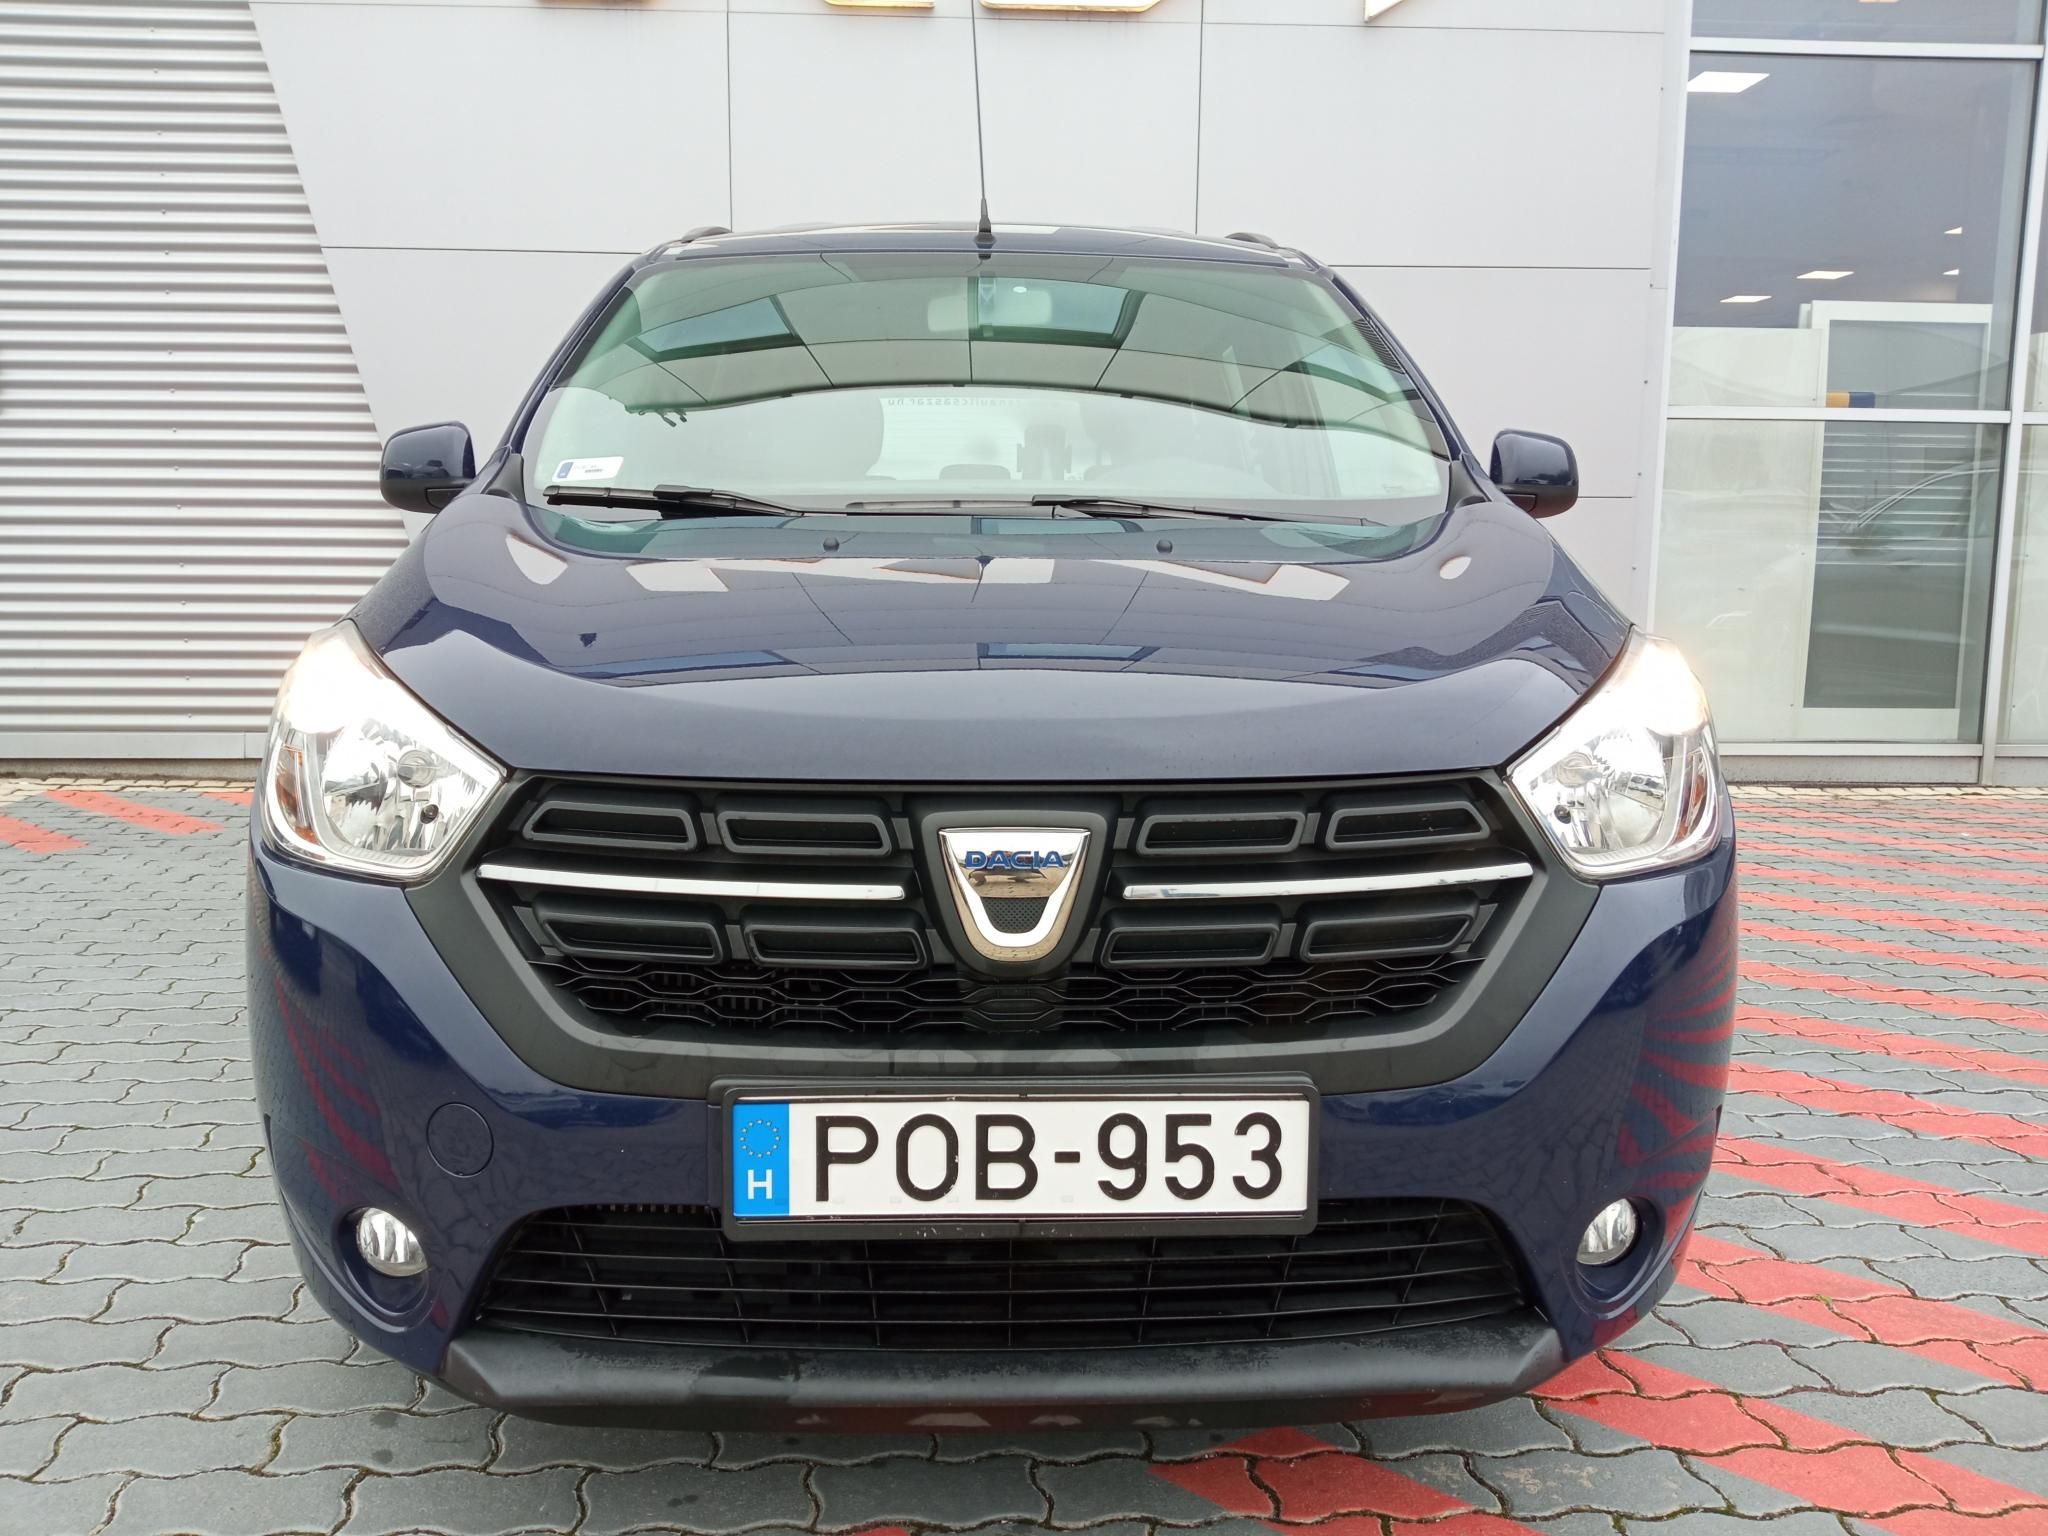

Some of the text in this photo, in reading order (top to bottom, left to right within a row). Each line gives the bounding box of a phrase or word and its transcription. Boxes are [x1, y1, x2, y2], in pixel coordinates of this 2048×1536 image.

[964, 850, 1066, 870] DACIA
[815, 1111, 1283, 1203] POB-953
[747, 1168, 773, 1200] H
